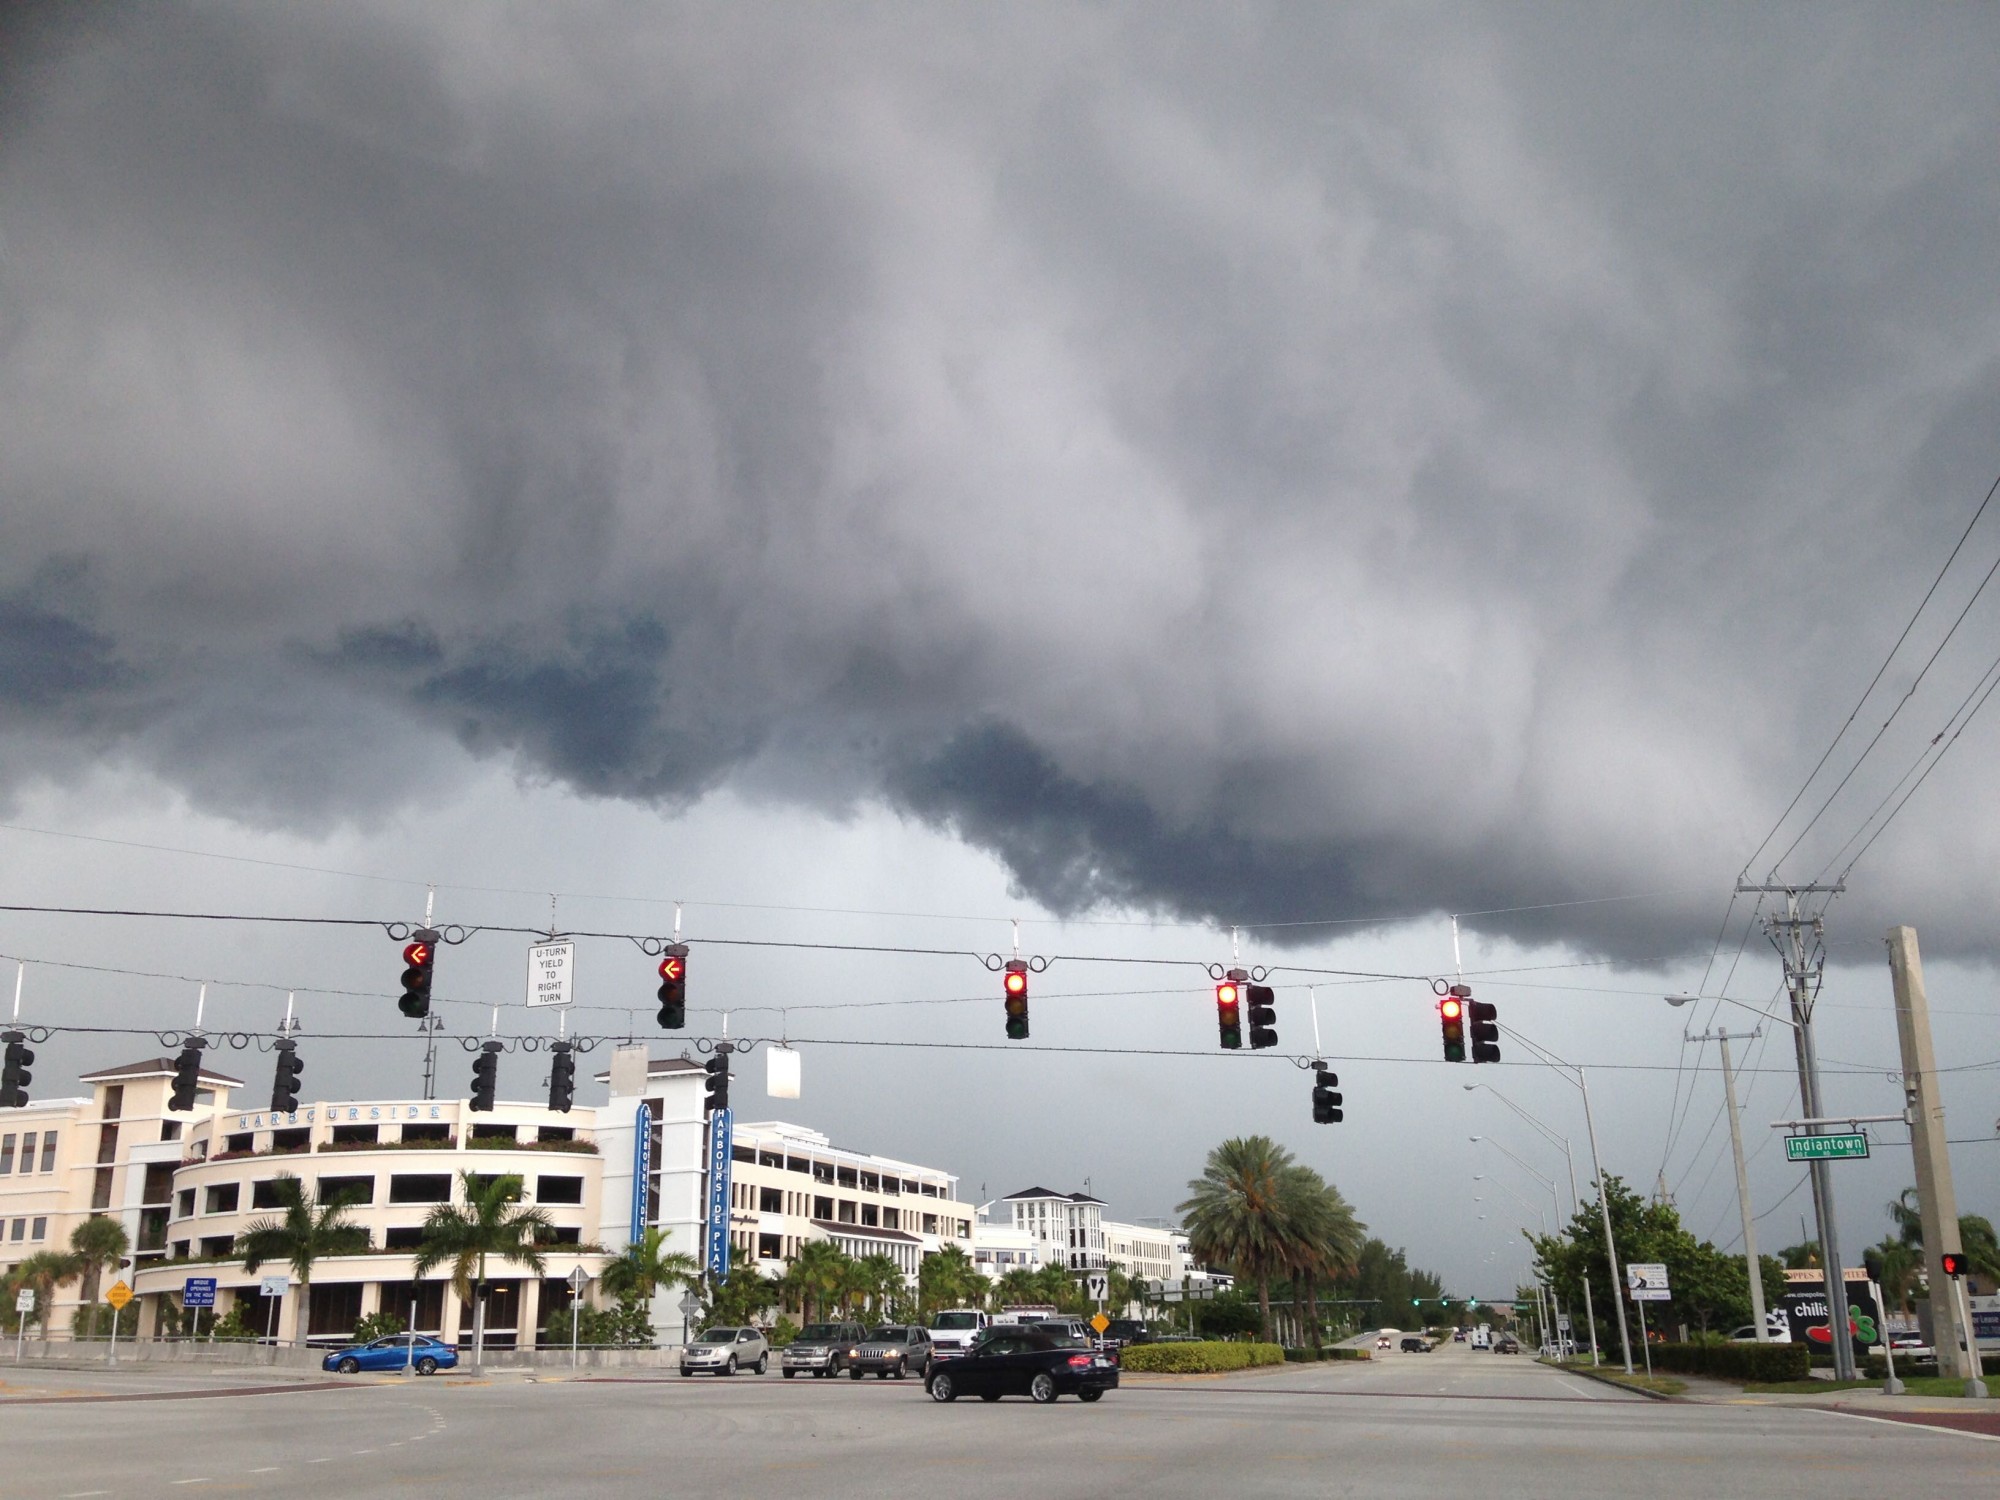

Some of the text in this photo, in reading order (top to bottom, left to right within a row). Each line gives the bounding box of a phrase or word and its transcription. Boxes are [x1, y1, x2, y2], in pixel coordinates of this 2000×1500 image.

[536, 947, 567, 958] U-TURN
[539, 959, 564, 969] YIELD
[545, 970, 556, 980] TO
[537, 981, 562, 991] RIGHT
[539, 993, 561, 1003] TURN
[239, 1105, 441, 1129] HARBOURSIDE
[1790, 1138, 1862, 1151] Indiantown
[640, 1109, 650, 1226] HARBOURSIDE
[712, 1109, 725, 1274] HARBOURSIDE PLAC
[1788, 1271, 1814, 1280] OPPES
